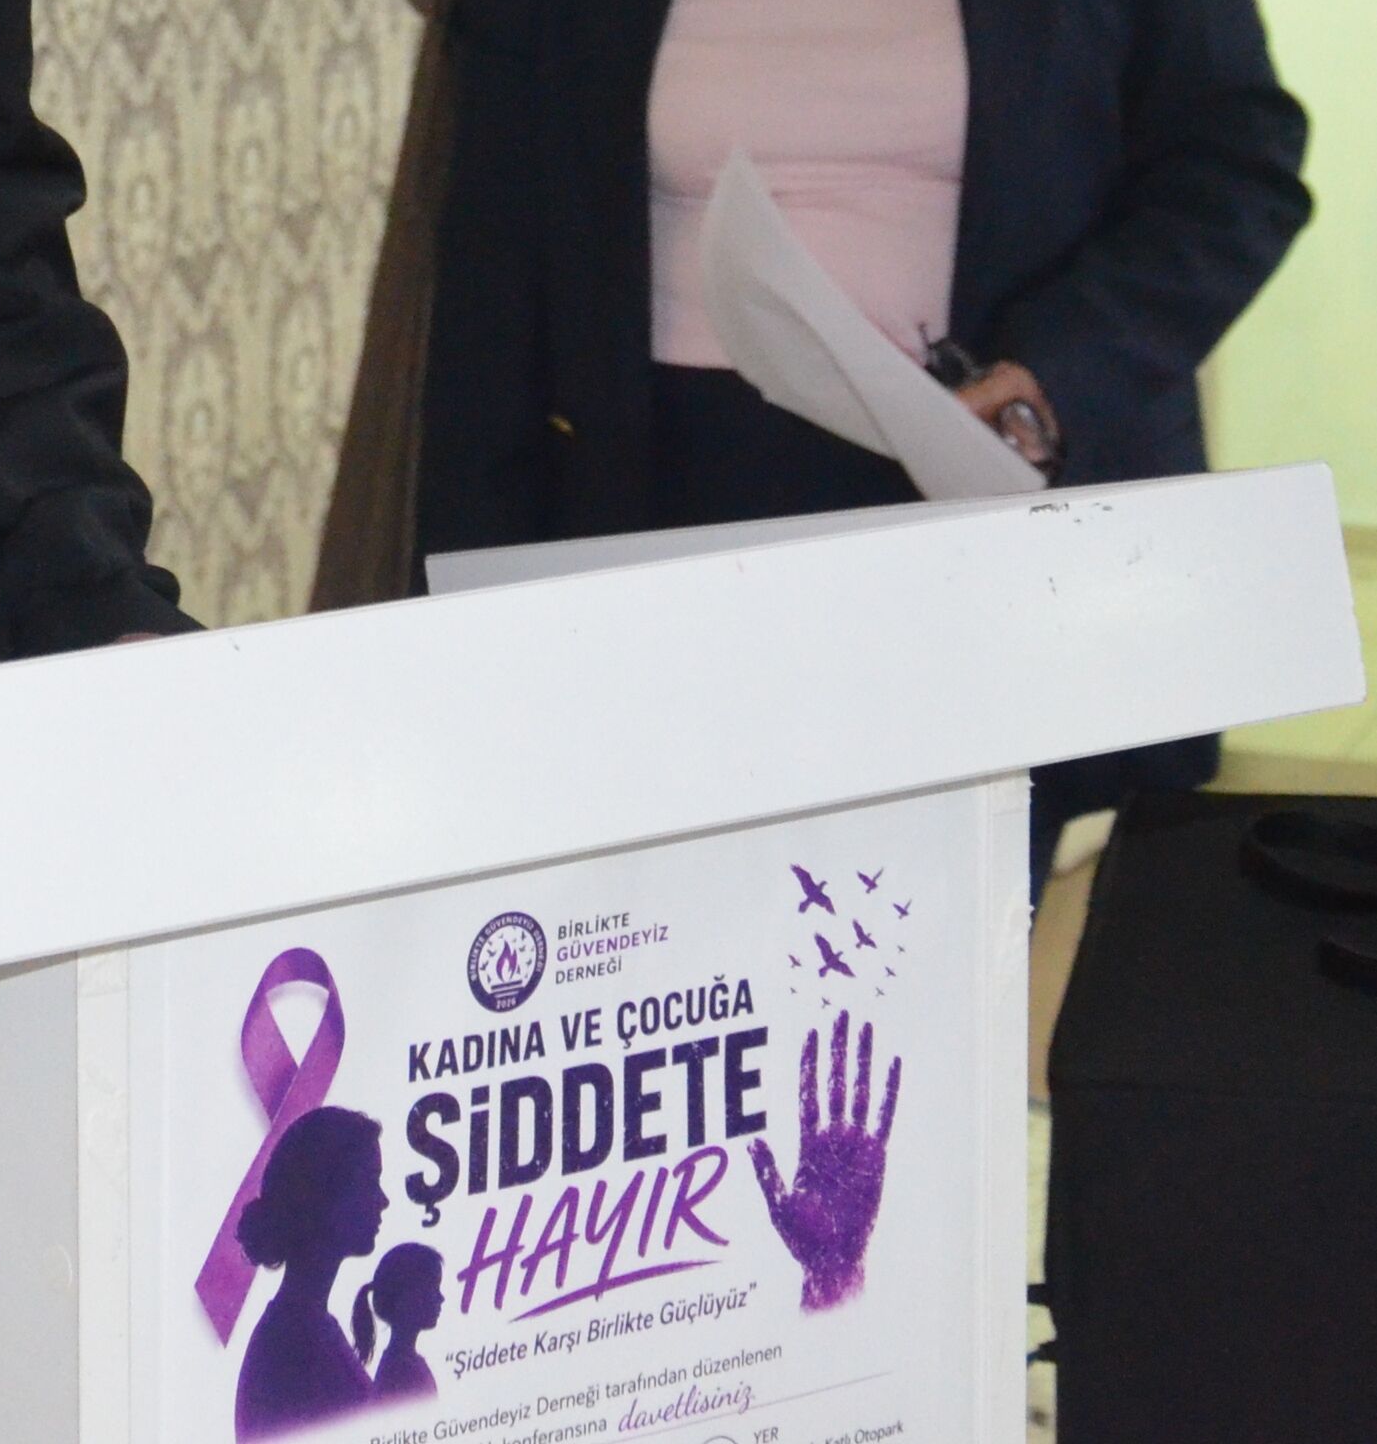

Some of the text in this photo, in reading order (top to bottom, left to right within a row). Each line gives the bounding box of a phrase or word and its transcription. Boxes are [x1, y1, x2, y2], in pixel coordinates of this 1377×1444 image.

[556, 923, 669, 963] GÜVENDEYİZ
[557, 912, 630, 941] BİRLİKTE
[555, 956, 622, 985] DERNEĞİ
[408, 974, 755, 1083] KADINA VE ÇOCUĞA
[456, 1145, 730, 1315] HAYIR
[533, 1330, 581, 1356] Karşı
[587, 1311, 654, 1344] Birlikte
[433, 1404, 531, 1441] Güvendeyiz
[537, 1383, 601, 1416] Derneği
[605, 1367, 687, 1399] tarafından
[693, 1345, 783, 1379] düzenlenen
[754, 1426, 779, 1444] YER
[854, 1420, 904, 1444] Otopark
